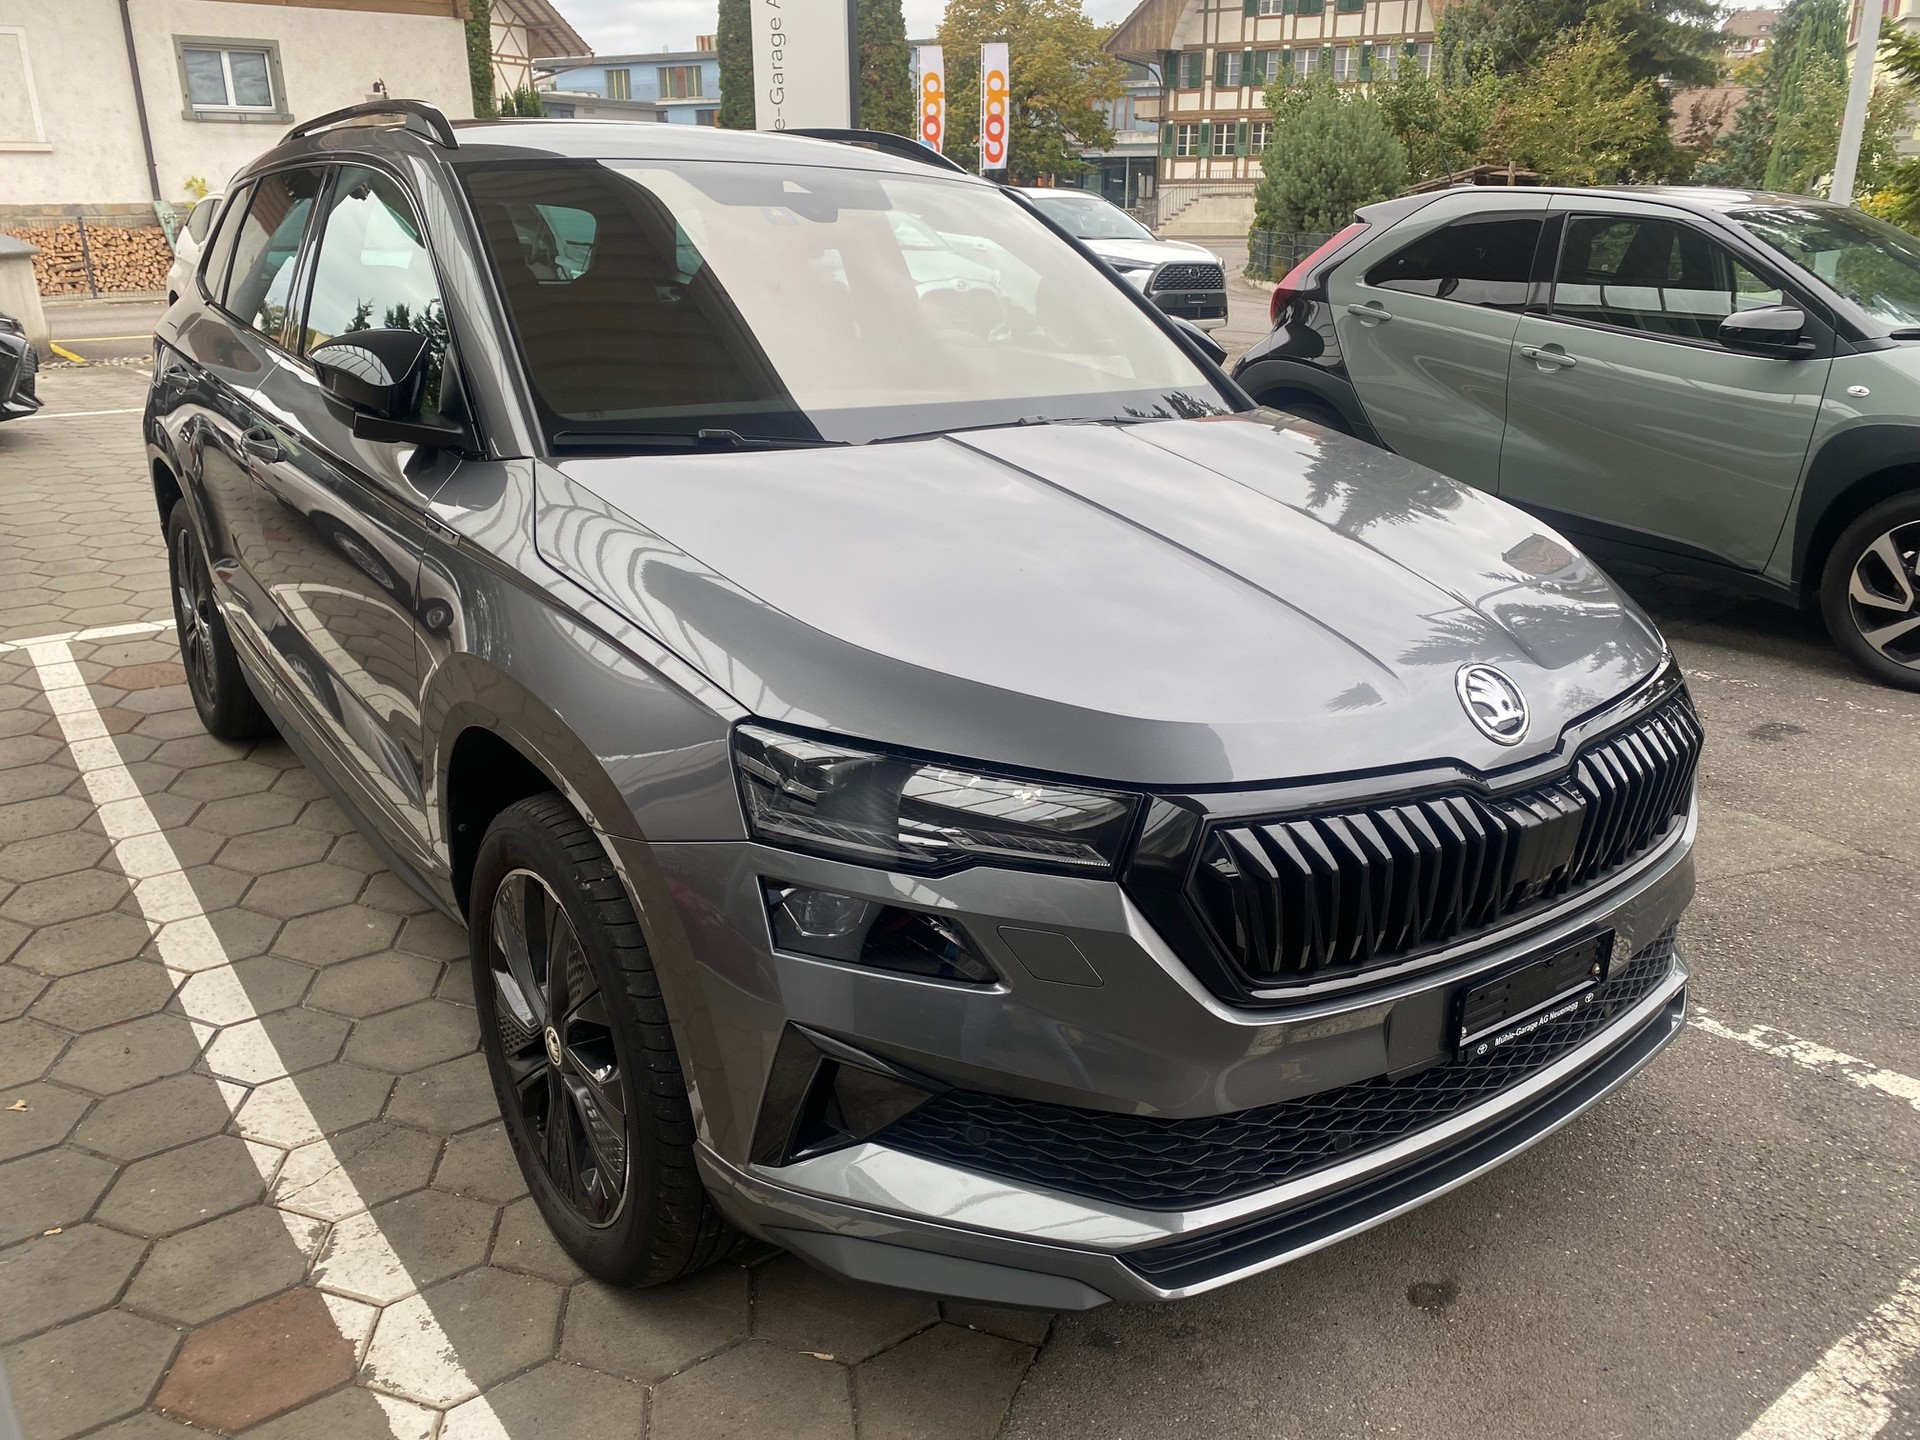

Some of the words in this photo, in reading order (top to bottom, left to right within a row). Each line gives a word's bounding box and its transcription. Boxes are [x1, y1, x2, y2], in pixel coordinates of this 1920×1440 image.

[984, 69, 1010, 163] coop
[1494, 1021, 1539, 1046] Mühle-Garage
[1538, 1014, 1549, 1026] AG
[1549, 1001, 1579, 1020] Neuenegg
